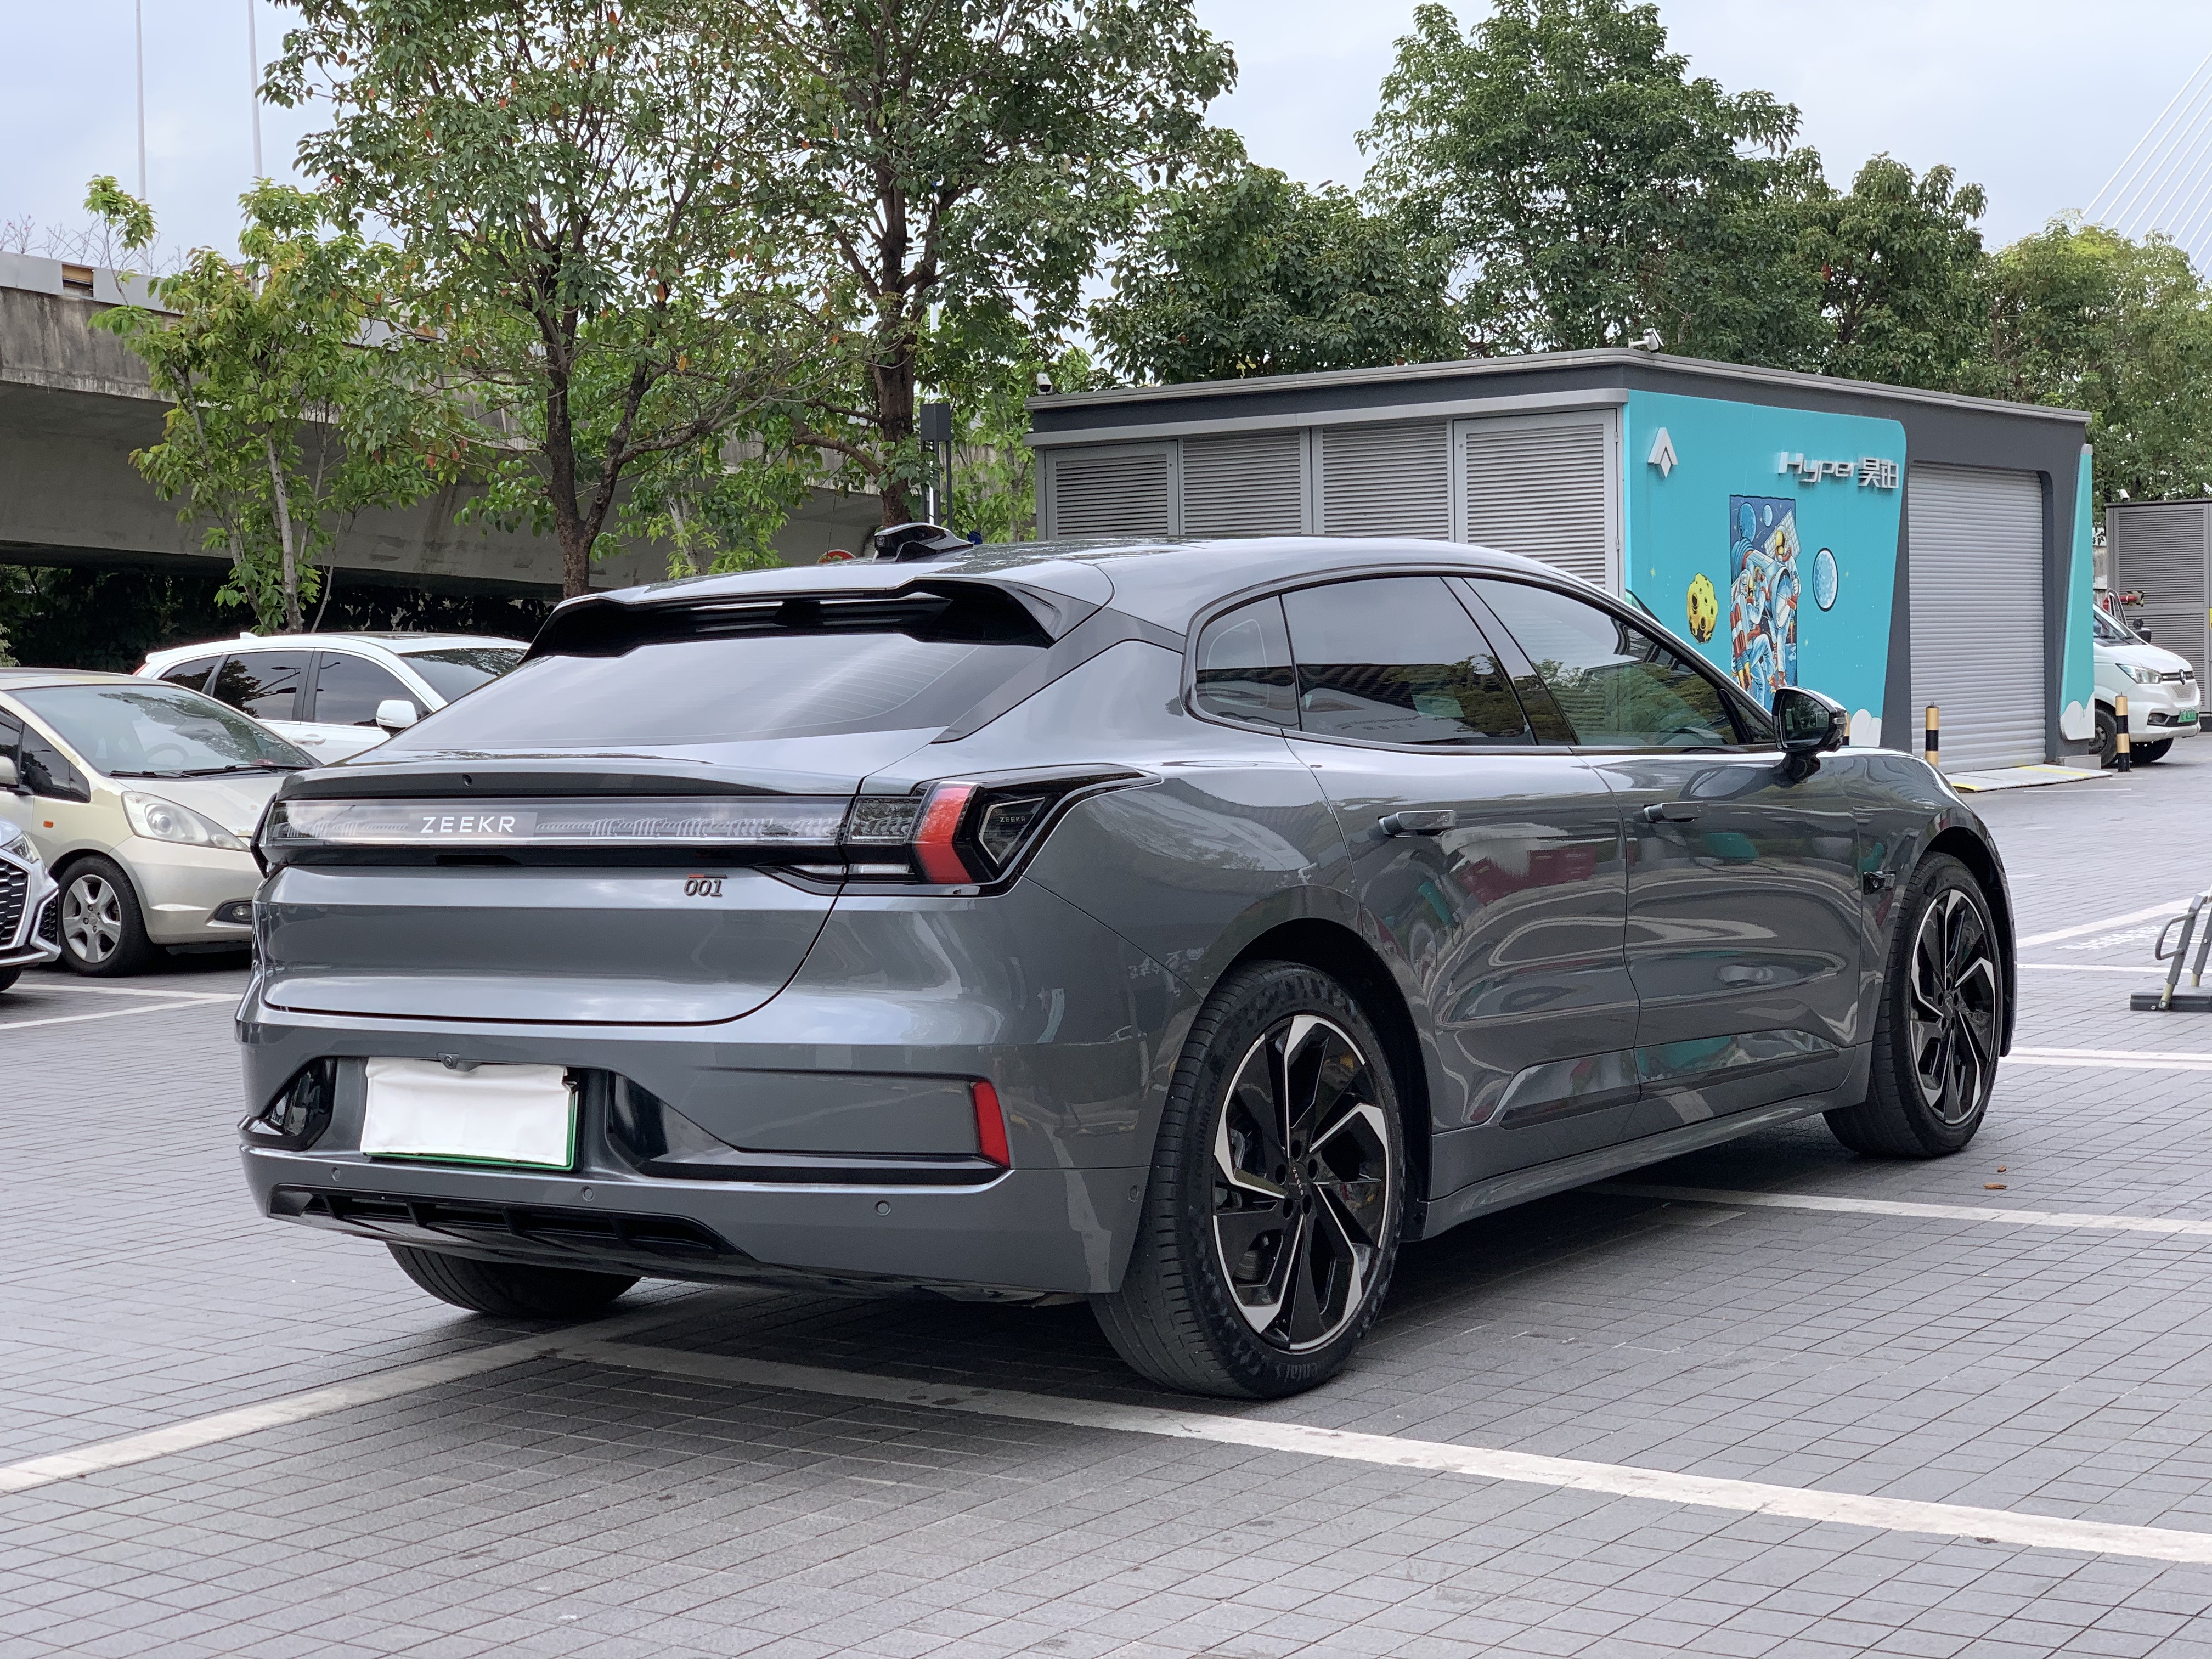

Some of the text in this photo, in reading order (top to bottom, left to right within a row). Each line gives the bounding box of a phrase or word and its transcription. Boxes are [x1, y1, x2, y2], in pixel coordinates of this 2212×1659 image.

[1778, 451, 1859, 483] Hyper
[420, 816, 515, 833] ZEEKR
[684, 878, 723, 897] 001
[1292, 1167, 1304, 1196] ZEEKR
